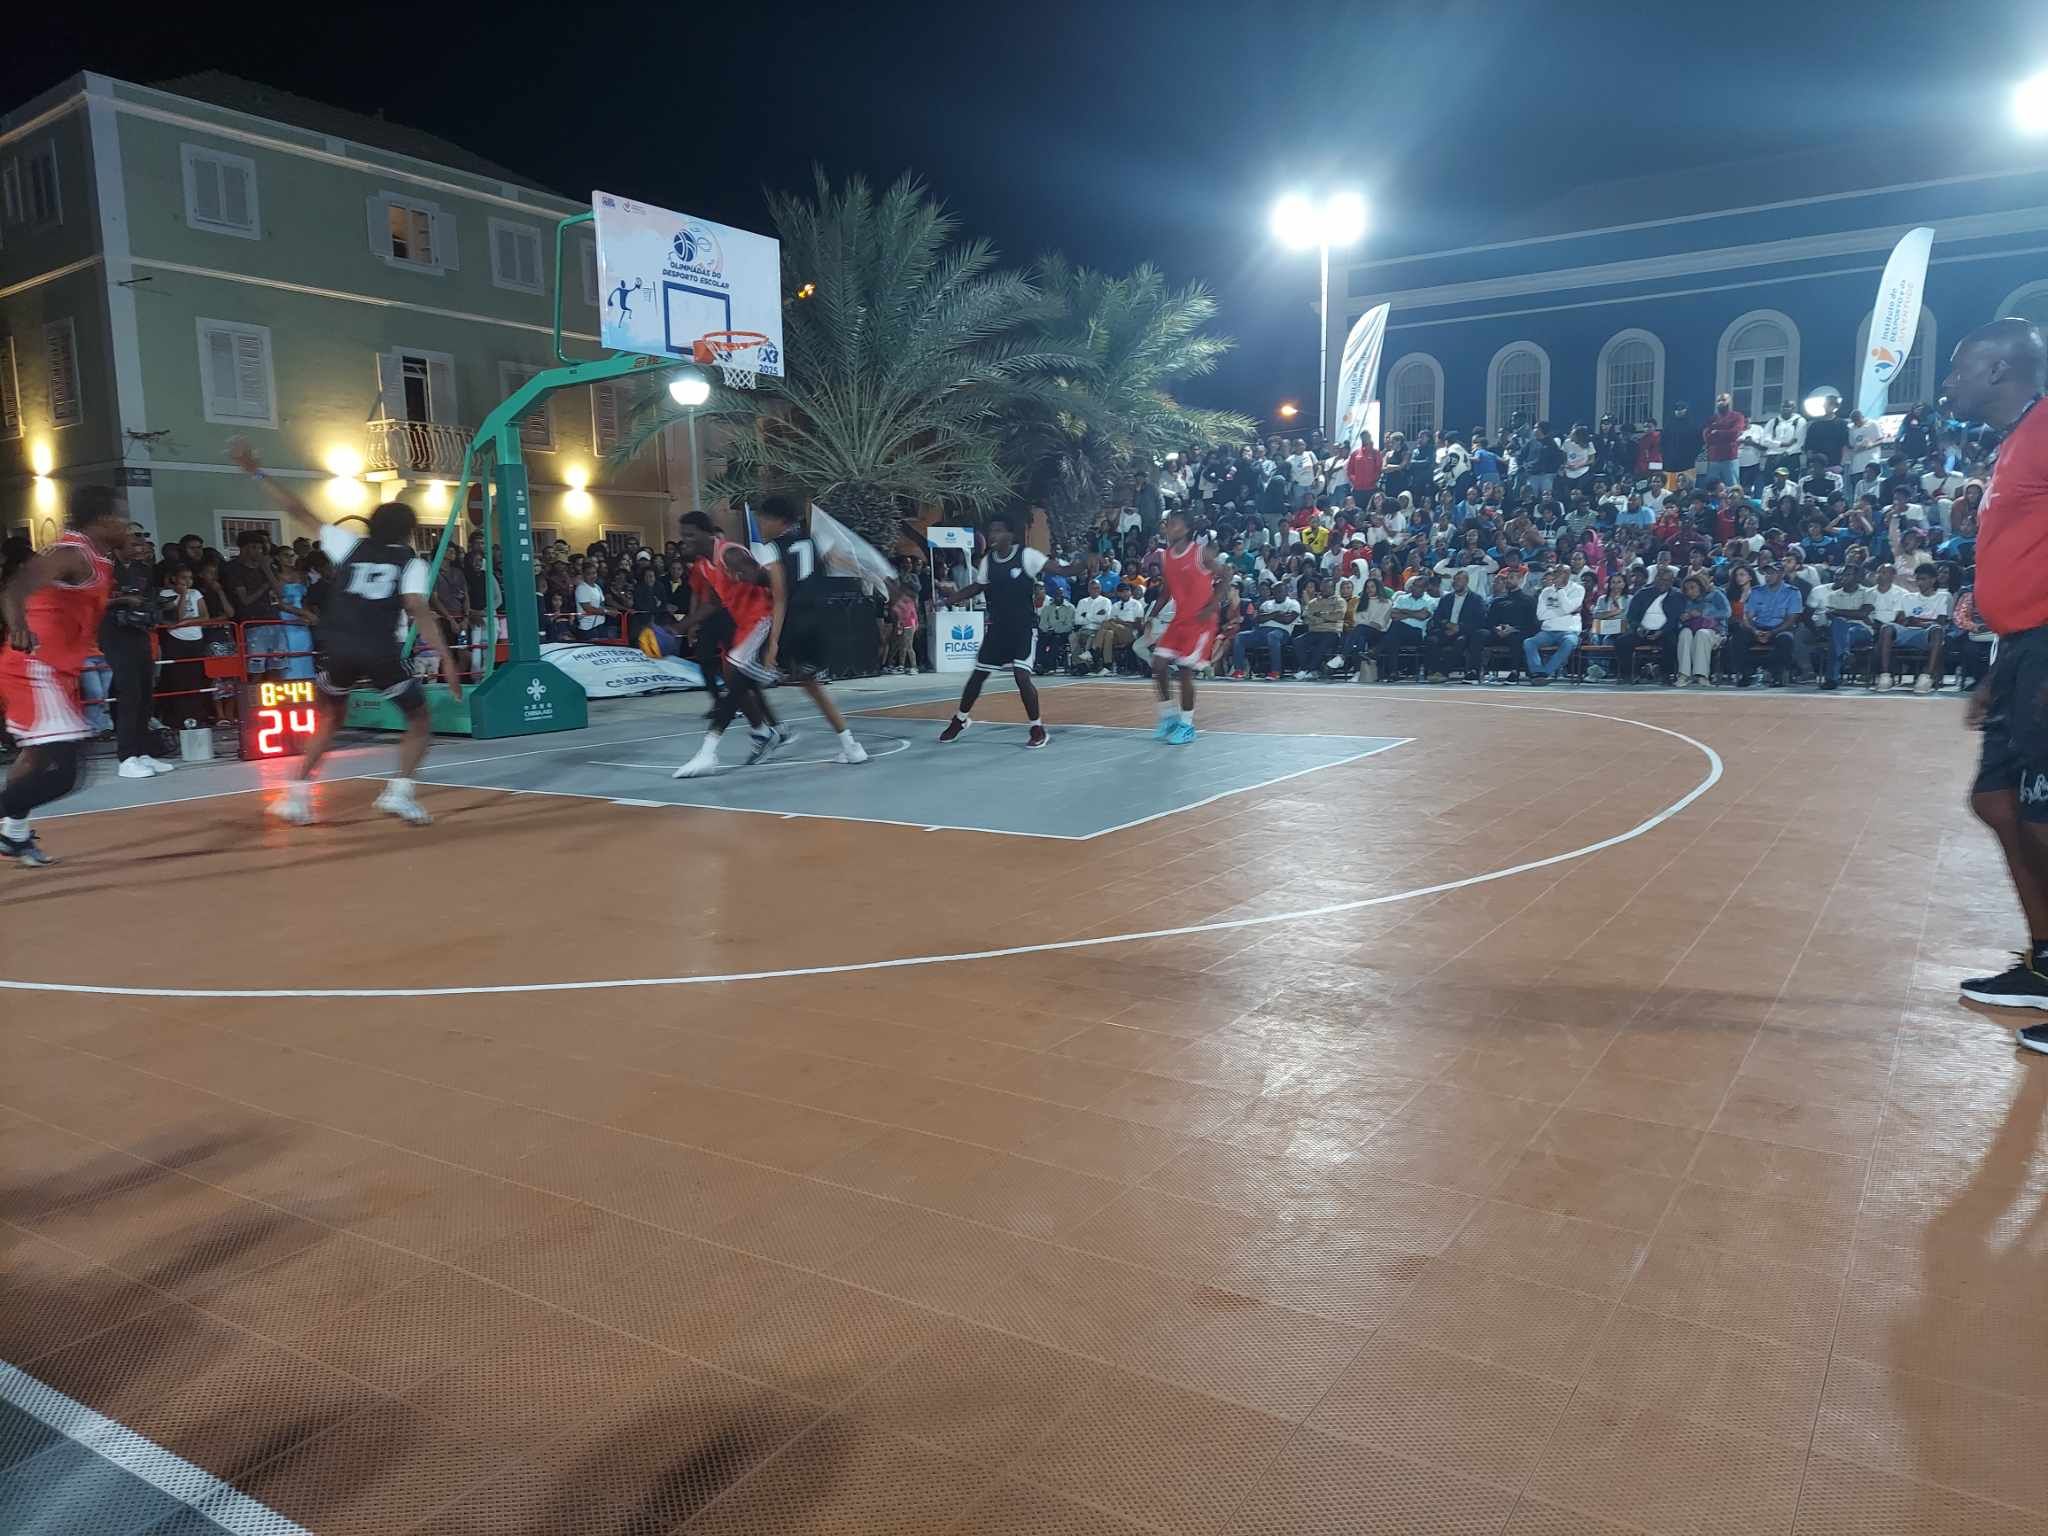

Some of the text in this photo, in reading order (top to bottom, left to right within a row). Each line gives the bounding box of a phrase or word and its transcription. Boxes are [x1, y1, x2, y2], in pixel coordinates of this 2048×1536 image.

[662, 268, 729, 289] DESPORTO ESCOLAR
[944, 642, 979, 652] FICASE
[261, 682, 313, 706] 8:44
[258, 709, 315, 753] 24
